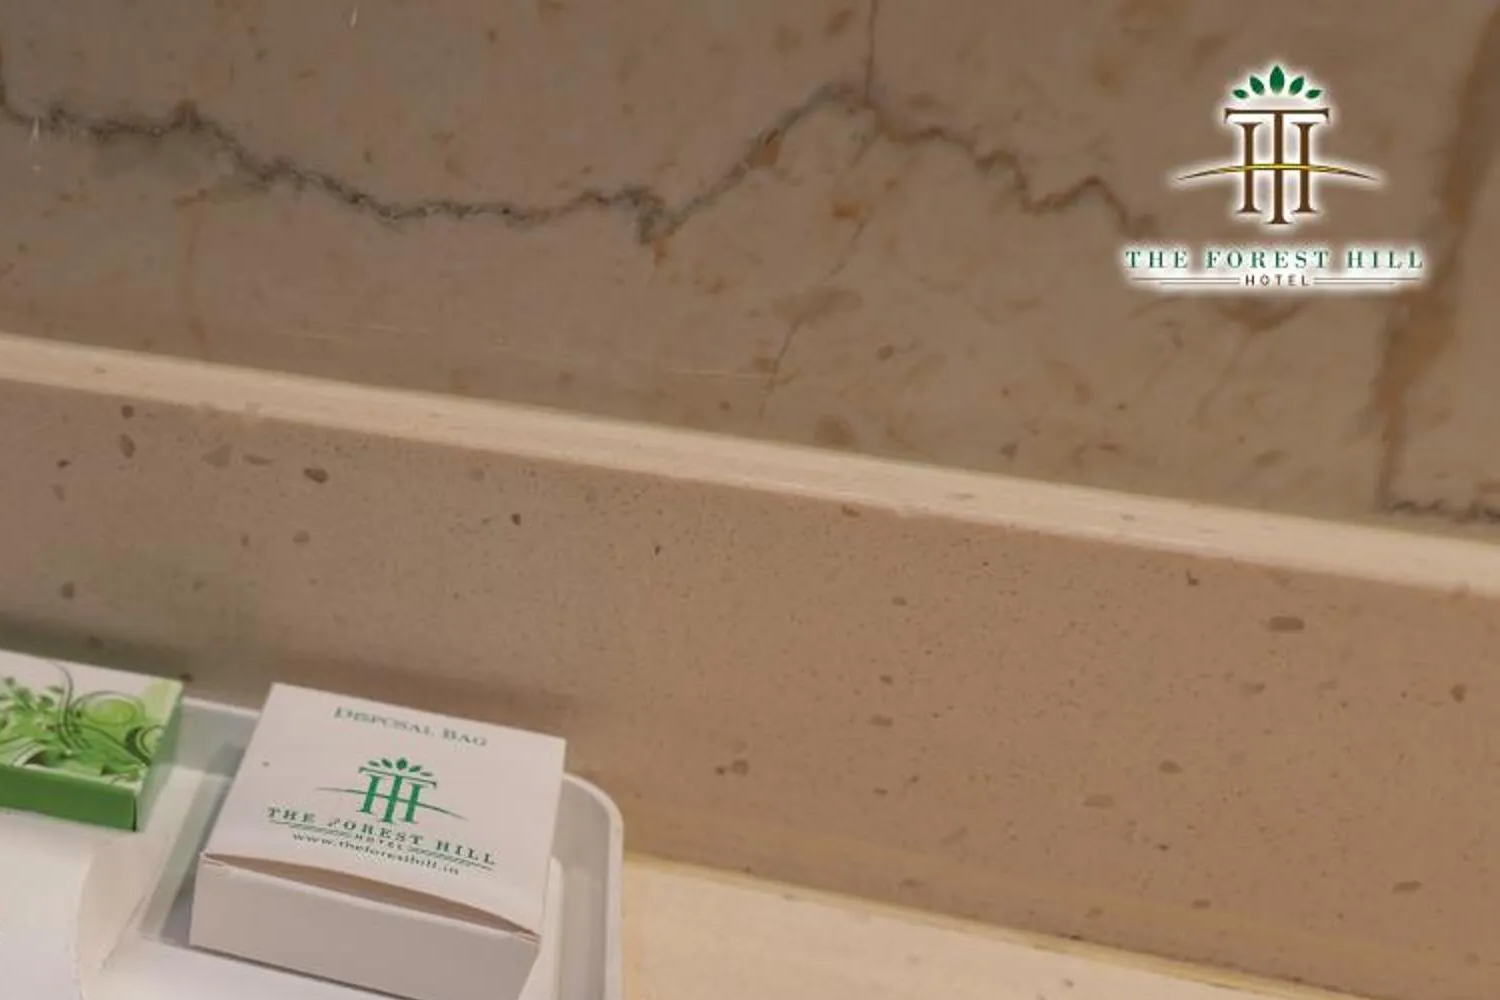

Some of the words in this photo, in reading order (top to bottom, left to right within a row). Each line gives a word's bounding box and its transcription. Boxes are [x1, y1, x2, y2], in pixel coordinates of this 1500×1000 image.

[333, 705, 435, 738] DISPOSAL
[442, 726, 488, 748] BAG
[267, 807, 317, 823] THE
[435, 839, 496, 866] HILL
